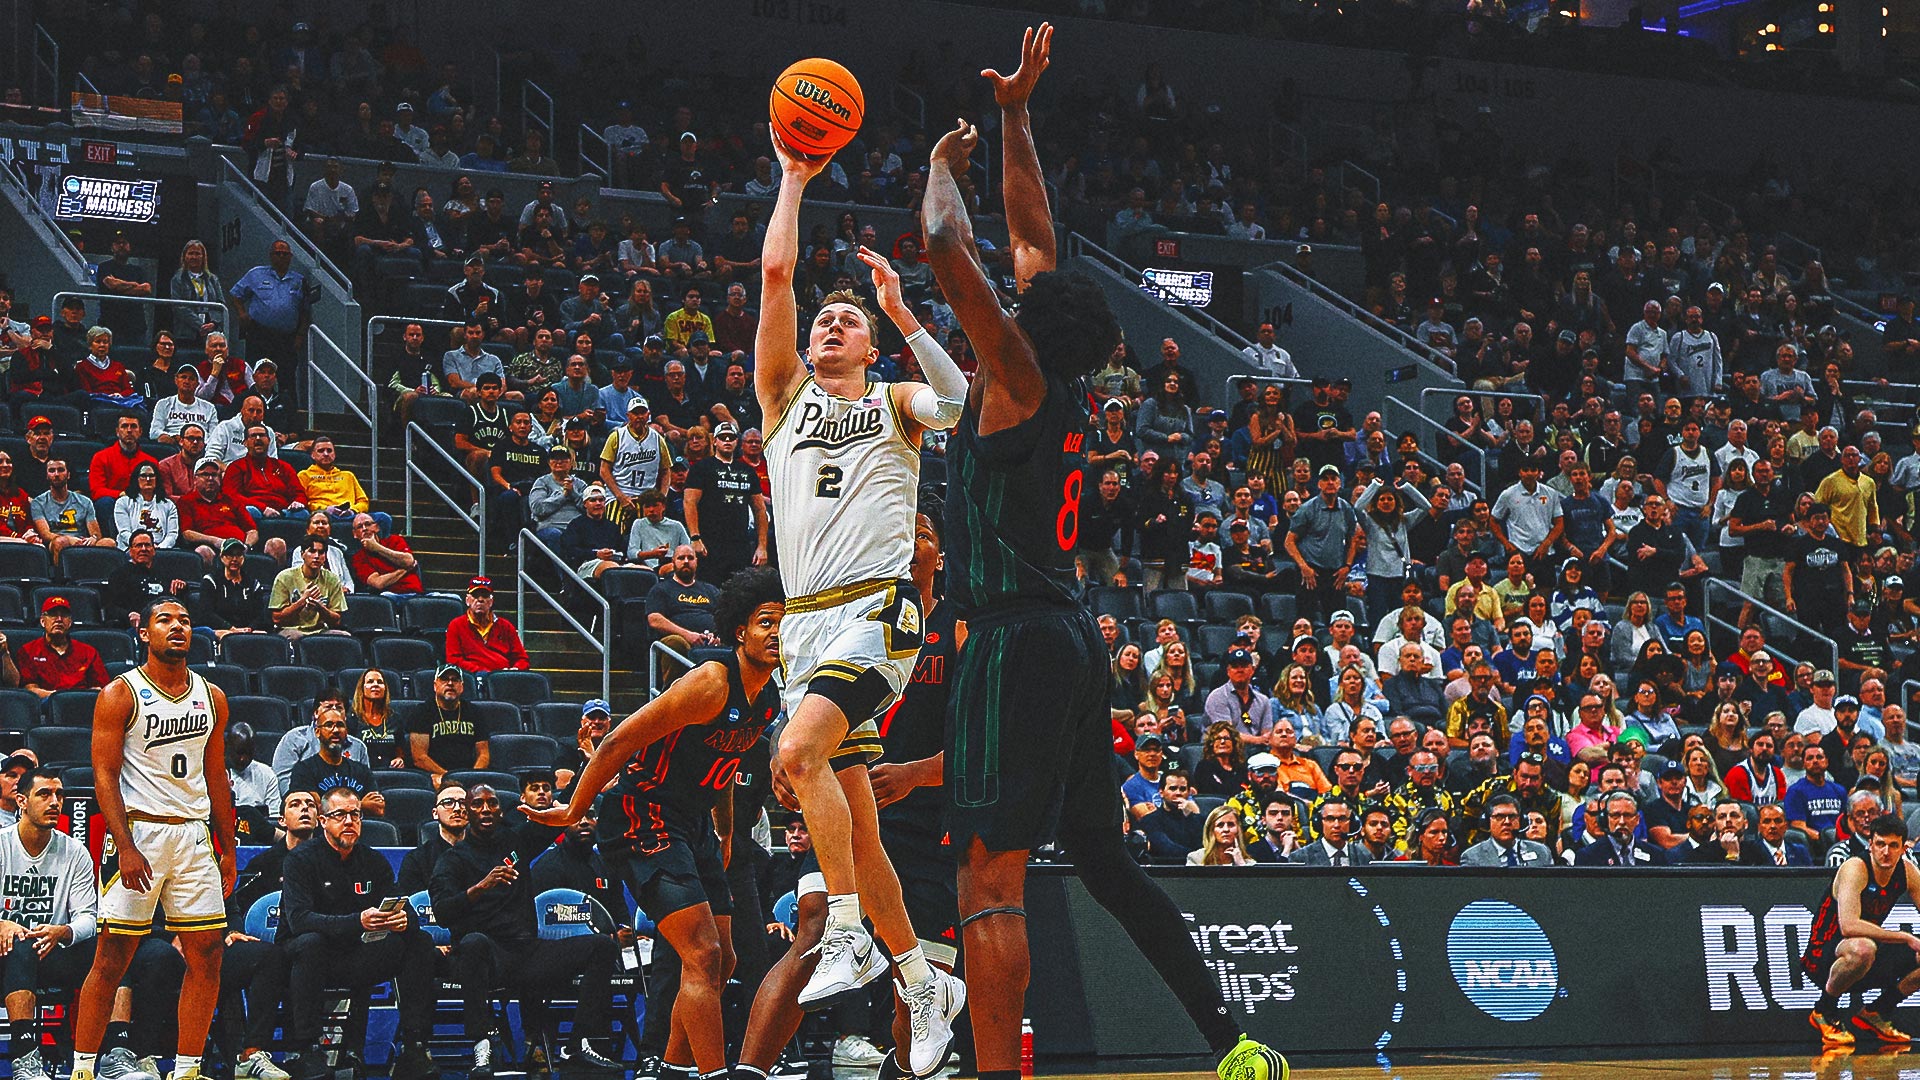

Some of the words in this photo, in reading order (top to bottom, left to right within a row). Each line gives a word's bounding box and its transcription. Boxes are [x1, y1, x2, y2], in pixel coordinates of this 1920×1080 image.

[793, 78, 851, 121] Wilson
[87, 145, 111, 161] EXIT
[79, 180, 130, 199] MARCH
[85, 196, 153, 215] MADNESS
[1157, 241, 1176, 256] EXIT
[1155, 272, 1193, 288] MARCH
[1697, 355, 1704, 367] 2
[794, 401, 882, 442] Purdue
[475, 426, 507, 441] PURDU
[506, 451, 540, 465] PURDUE
[620, 449, 657, 466] Purdue
[631, 469, 646, 488] 17
[814, 464, 844, 498] 2
[1056, 469, 1084, 550] 8
[143, 713, 209, 740] Purdue
[431, 719, 475, 739] PURDUE
[170, 753, 188, 779] 0
[699, 757, 741, 790] 10
[73, 800, 87, 844] RMOR
[2, 874, 58, 898] LEGACY
[354, 881, 372, 894] U
[25, 900, 51, 911] ON
[1463, 959, 1557, 989] NCAA
[1204, 958, 1296, 1014] lips
